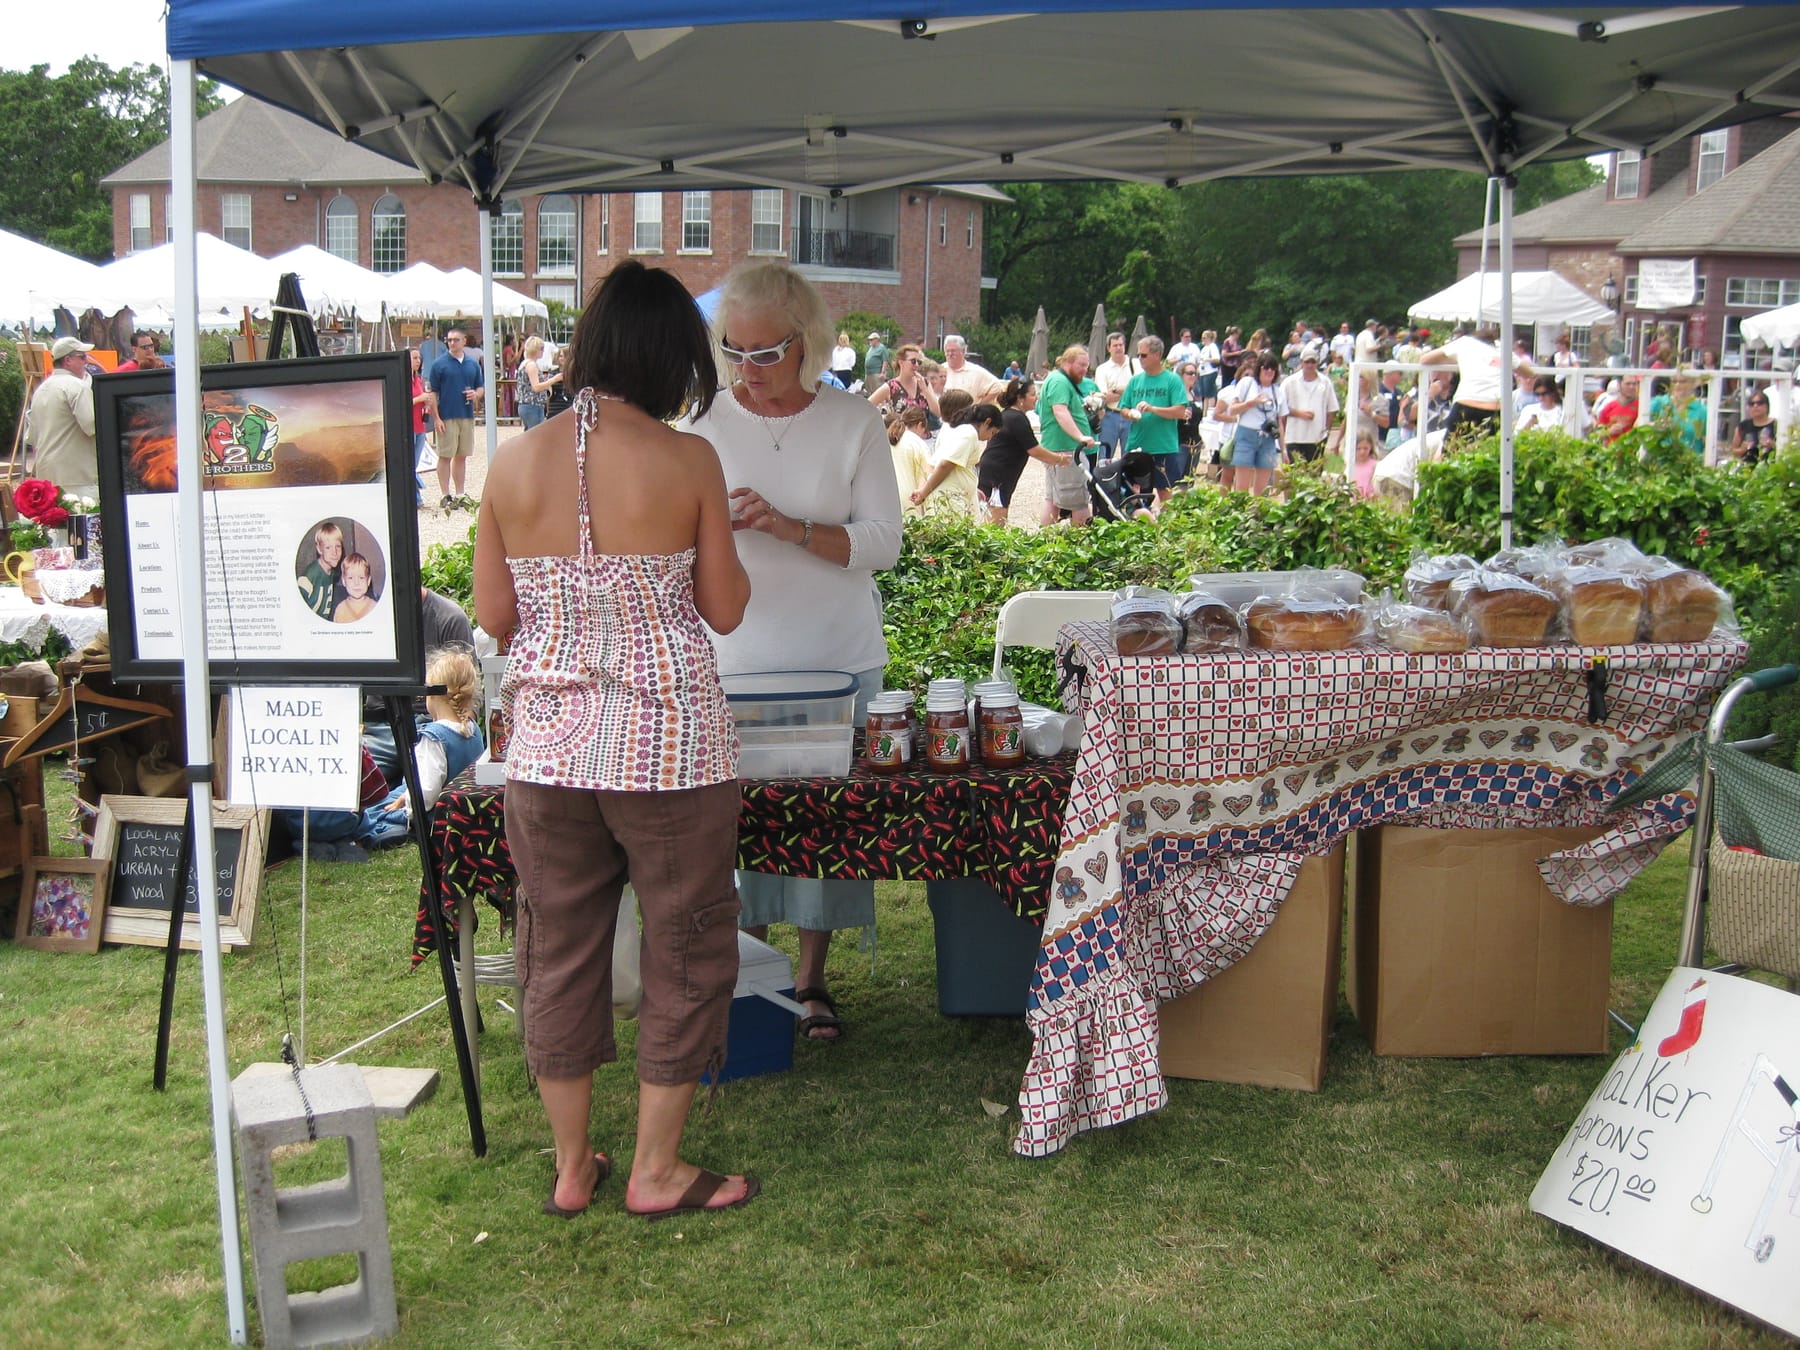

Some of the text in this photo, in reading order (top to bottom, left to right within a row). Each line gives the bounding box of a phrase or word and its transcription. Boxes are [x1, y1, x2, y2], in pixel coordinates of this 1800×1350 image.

[225, 446, 248, 464] 2
[206, 463, 272, 474] BROTHERS
[266, 700, 322, 717] MADE
[249, 728, 340, 746] LOCAL IN
[241, 756, 348, 777] BRYAN, TX.
[126, 828, 160, 840] LOCAL
[120, 862, 163, 876] URBAN
[131, 883, 165, 900] Wood
